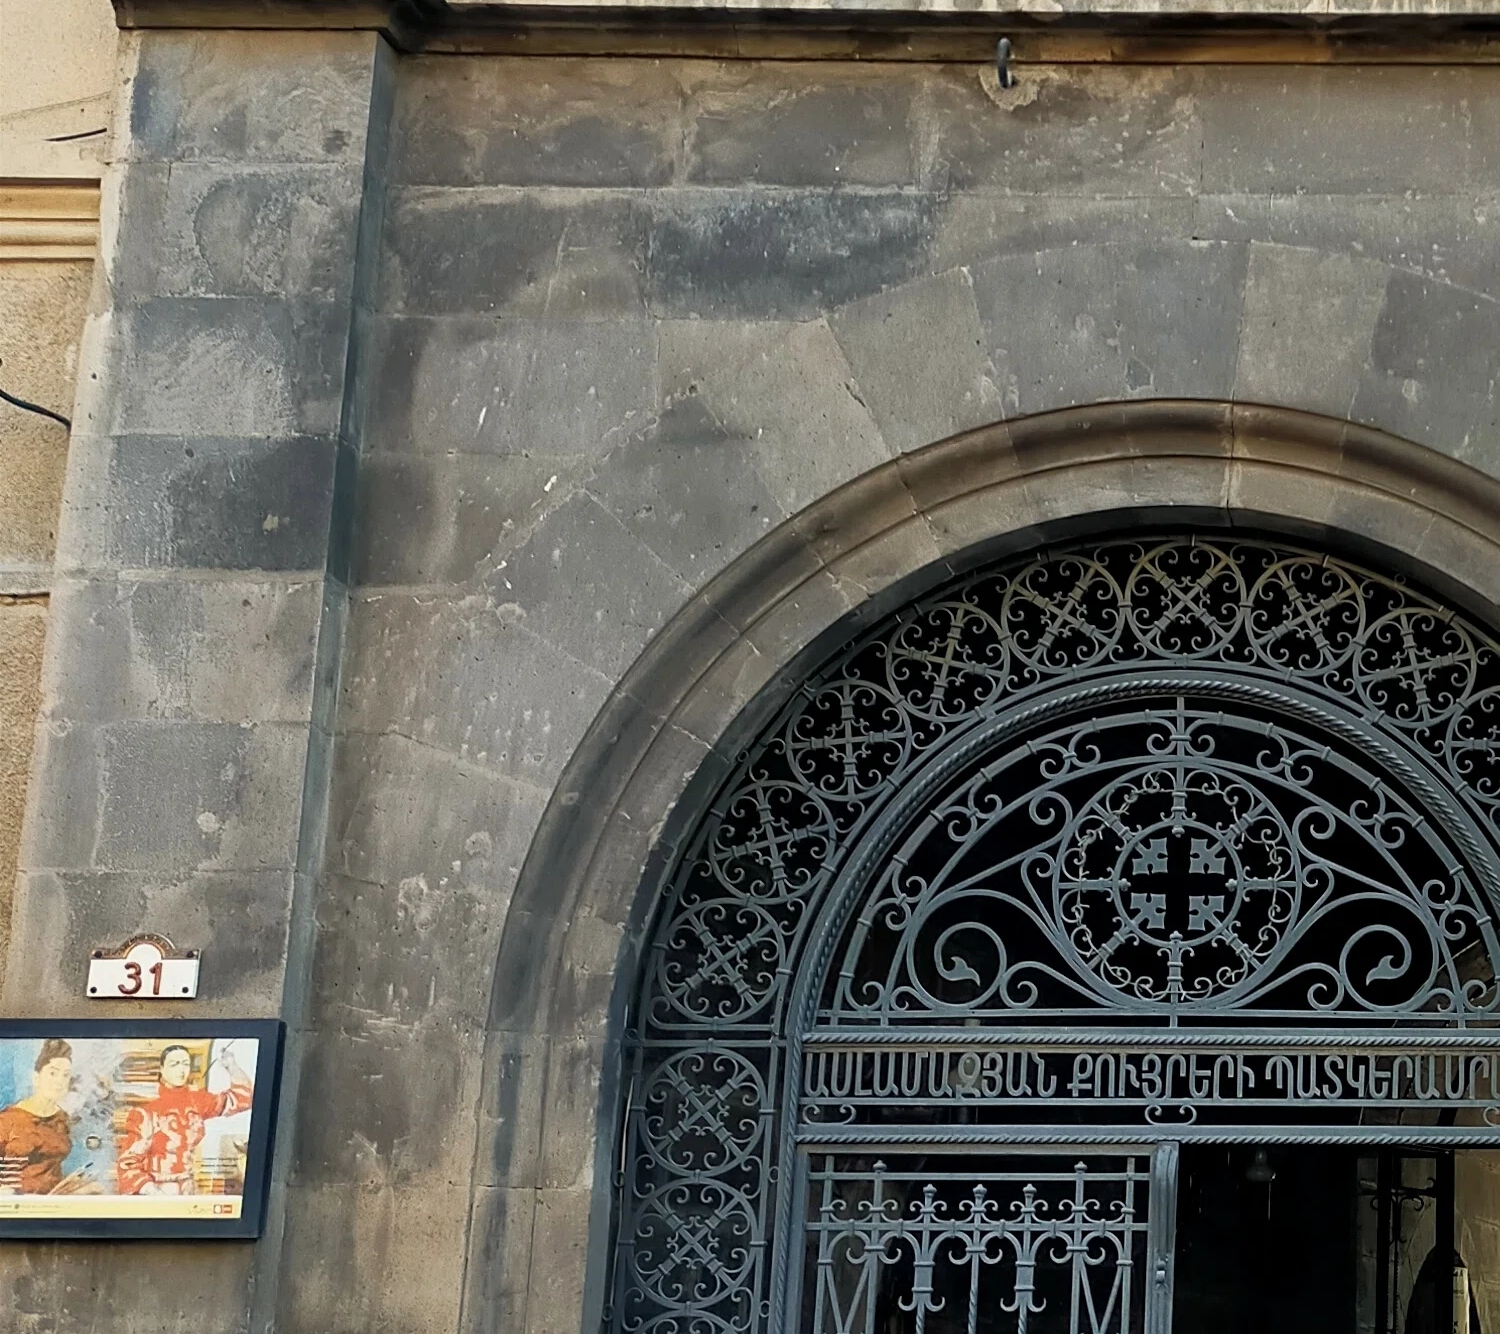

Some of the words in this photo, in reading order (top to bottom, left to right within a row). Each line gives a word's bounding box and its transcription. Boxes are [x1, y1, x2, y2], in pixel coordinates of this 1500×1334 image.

[117, 961, 163, 996] 31
[804, 1051, 1057, 1099] ԱՍԼԱՄԱԶՅԱՆ
[1066, 1052, 1255, 1100] ՔՈՒՅՐԵՐԻ
